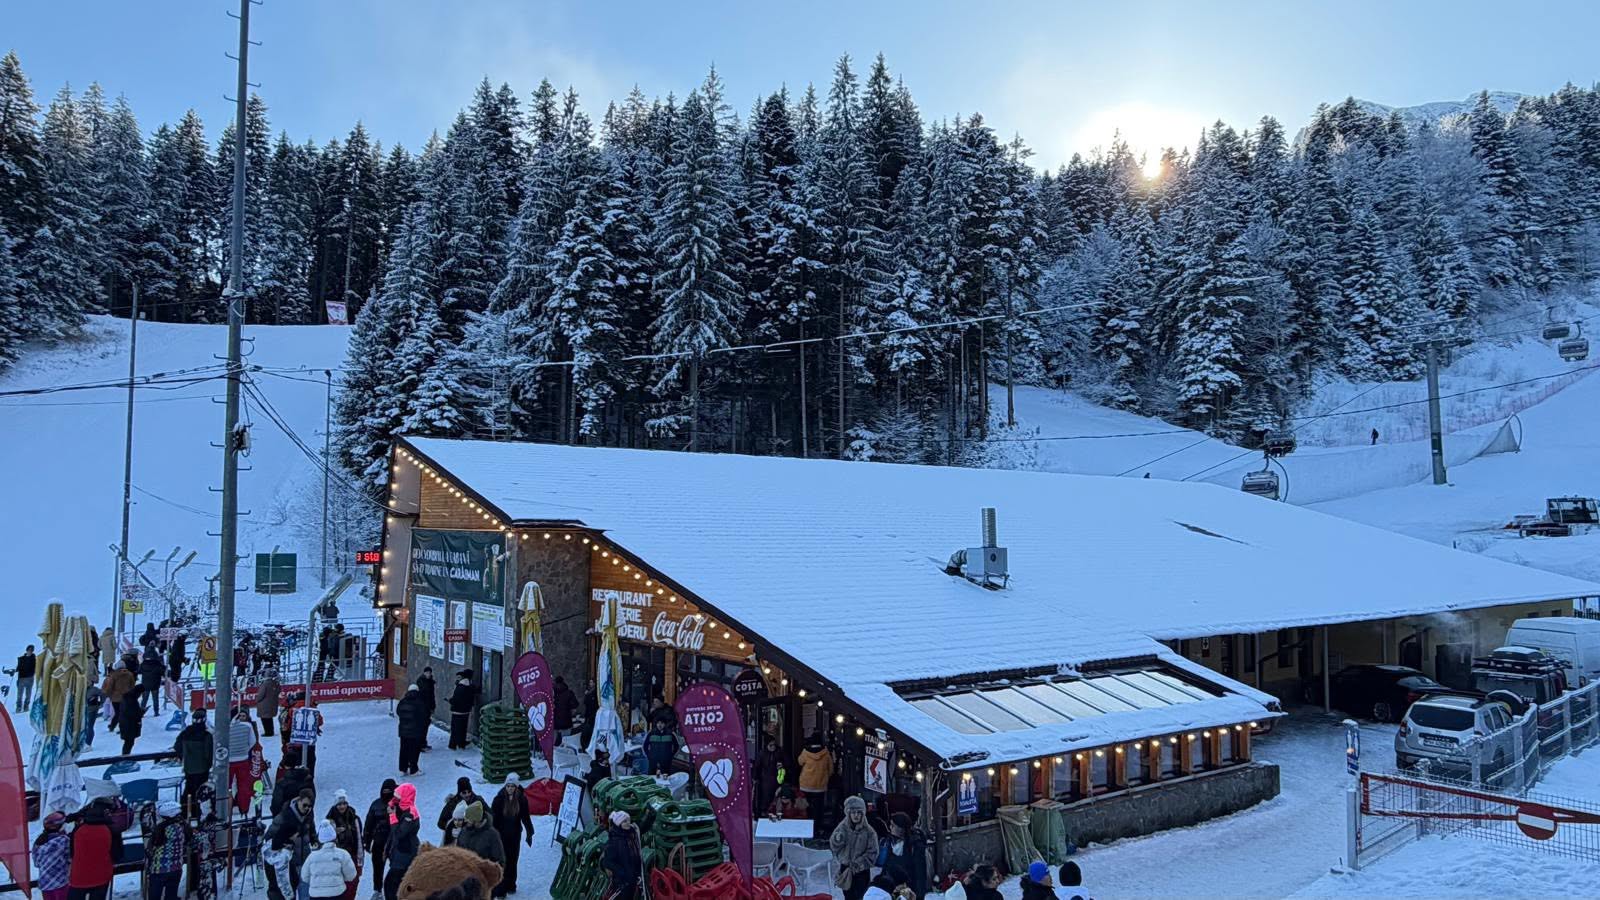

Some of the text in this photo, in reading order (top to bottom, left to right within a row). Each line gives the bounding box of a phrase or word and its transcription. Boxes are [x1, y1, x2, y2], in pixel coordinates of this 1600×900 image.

[592, 588, 654, 607] RESURANT
[652, 611, 708, 651] Coca-Cola
[341, 685, 383, 698] aproape
[735, 682, 763, 692] COSTA
